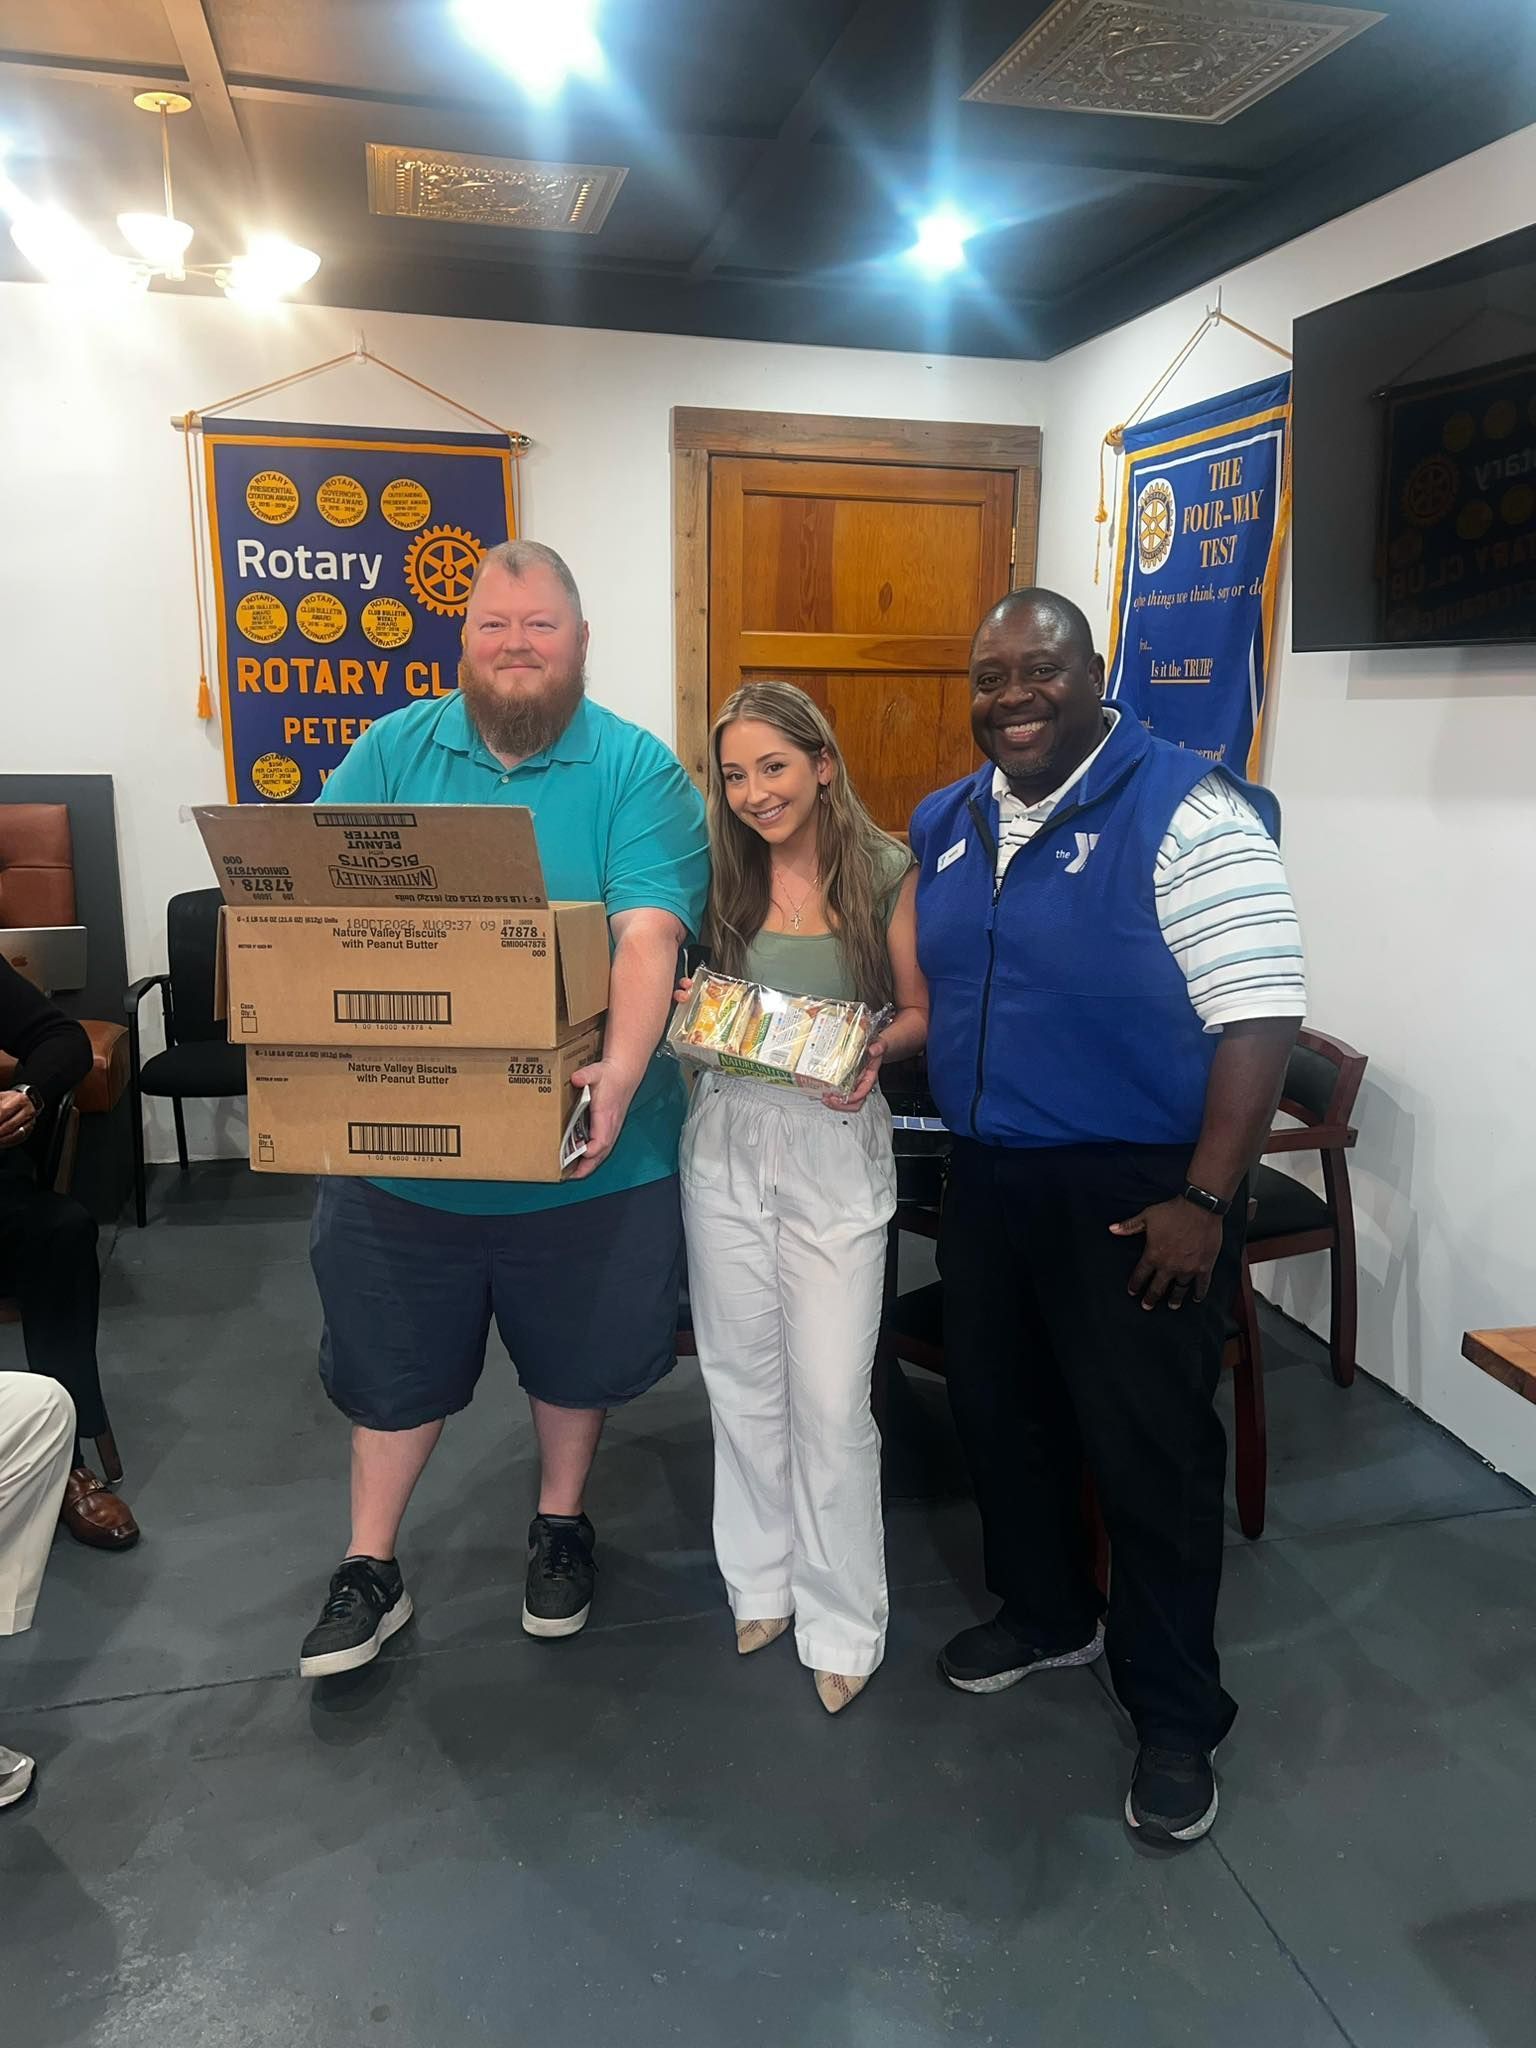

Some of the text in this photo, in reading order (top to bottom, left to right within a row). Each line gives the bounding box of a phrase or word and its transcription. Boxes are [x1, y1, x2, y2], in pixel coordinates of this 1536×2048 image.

[254, 474, 289, 486] ROTARY
[1209, 456, 1243, 492] THE
[249, 485, 295, 495] PRESIDENTIAL
[325, 478, 359, 490] ROTARY
[390, 481, 419, 490] ROTARY
[247, 492, 297, 502] CITATION AWARD
[321, 489, 362, 499] GOVERNOR'S
[319, 496, 364, 506] CIRCLE AWARD
[249, 501, 296, 521] INTERNATIONAL
[320, 504, 364, 524] INTERNATIONAL
[1182, 489, 1264, 535] FOUR-WAY
[387, 513, 429, 528] INTERNATIONAL
[1200, 535, 1238, 568] TEST
[237, 538, 383, 590] Rotary
[246, 594, 275, 604] ROTARY
[305, 595, 338, 606] ROTARY
[1147, 589, 1176, 610] things
[1231, 585, 1245, 598] or
[370, 599, 402, 609] ROTARY
[300, 606, 343, 616] CLUB BULLETIN
[244, 626, 285, 641] INTERNATIONAL
[299, 621, 344, 640] INTERNATIONAL
[365, 626, 410, 647] INTERNATIONAL
[1151, 657, 1214, 677] Is it the TRUTH?
[236, 656, 464, 697] ROTARY CL
[260, 754, 291, 764] ROTARY
[255, 779, 300, 798] INTERNATIONAL
[343, 830, 400, 840] BUTTER
[347, 840, 402, 850] PEANUT
[222, 855, 243, 865] 000
[1055, 849, 1071, 859] the
[338, 854, 420, 869] BISCUITS
[226, 866, 290, 876] GMI0047878
[336, 868, 433, 888] NATURE VALLEY
[242, 878, 294, 892] 47878
[394, 894, 416, 902] Units
[480, 920, 496, 931] 09
[332, 928, 448, 940] Nature Valley Biscuits
[500, 926, 538, 938] 47878
[341, 938, 439, 950] with Peanut Butter
[501, 940, 547, 949] GMI0047878
[531, 949, 547, 958] 000
[240, 1002, 254, 1010] Case
[348, 1062, 458, 1075] Nature Valley Biscuits
[508, 1063, 544, 1075] 47878
[720, 1053, 756, 1072] NATURE
[757, 1063, 790, 1080] VALLEY
[356, 1073, 450, 1085] with Peanut Butter
[508, 1076, 552, 1085] GMI0047878
[538, 1086, 552, 1094] 000
[258, 1132, 271, 1140] Case
